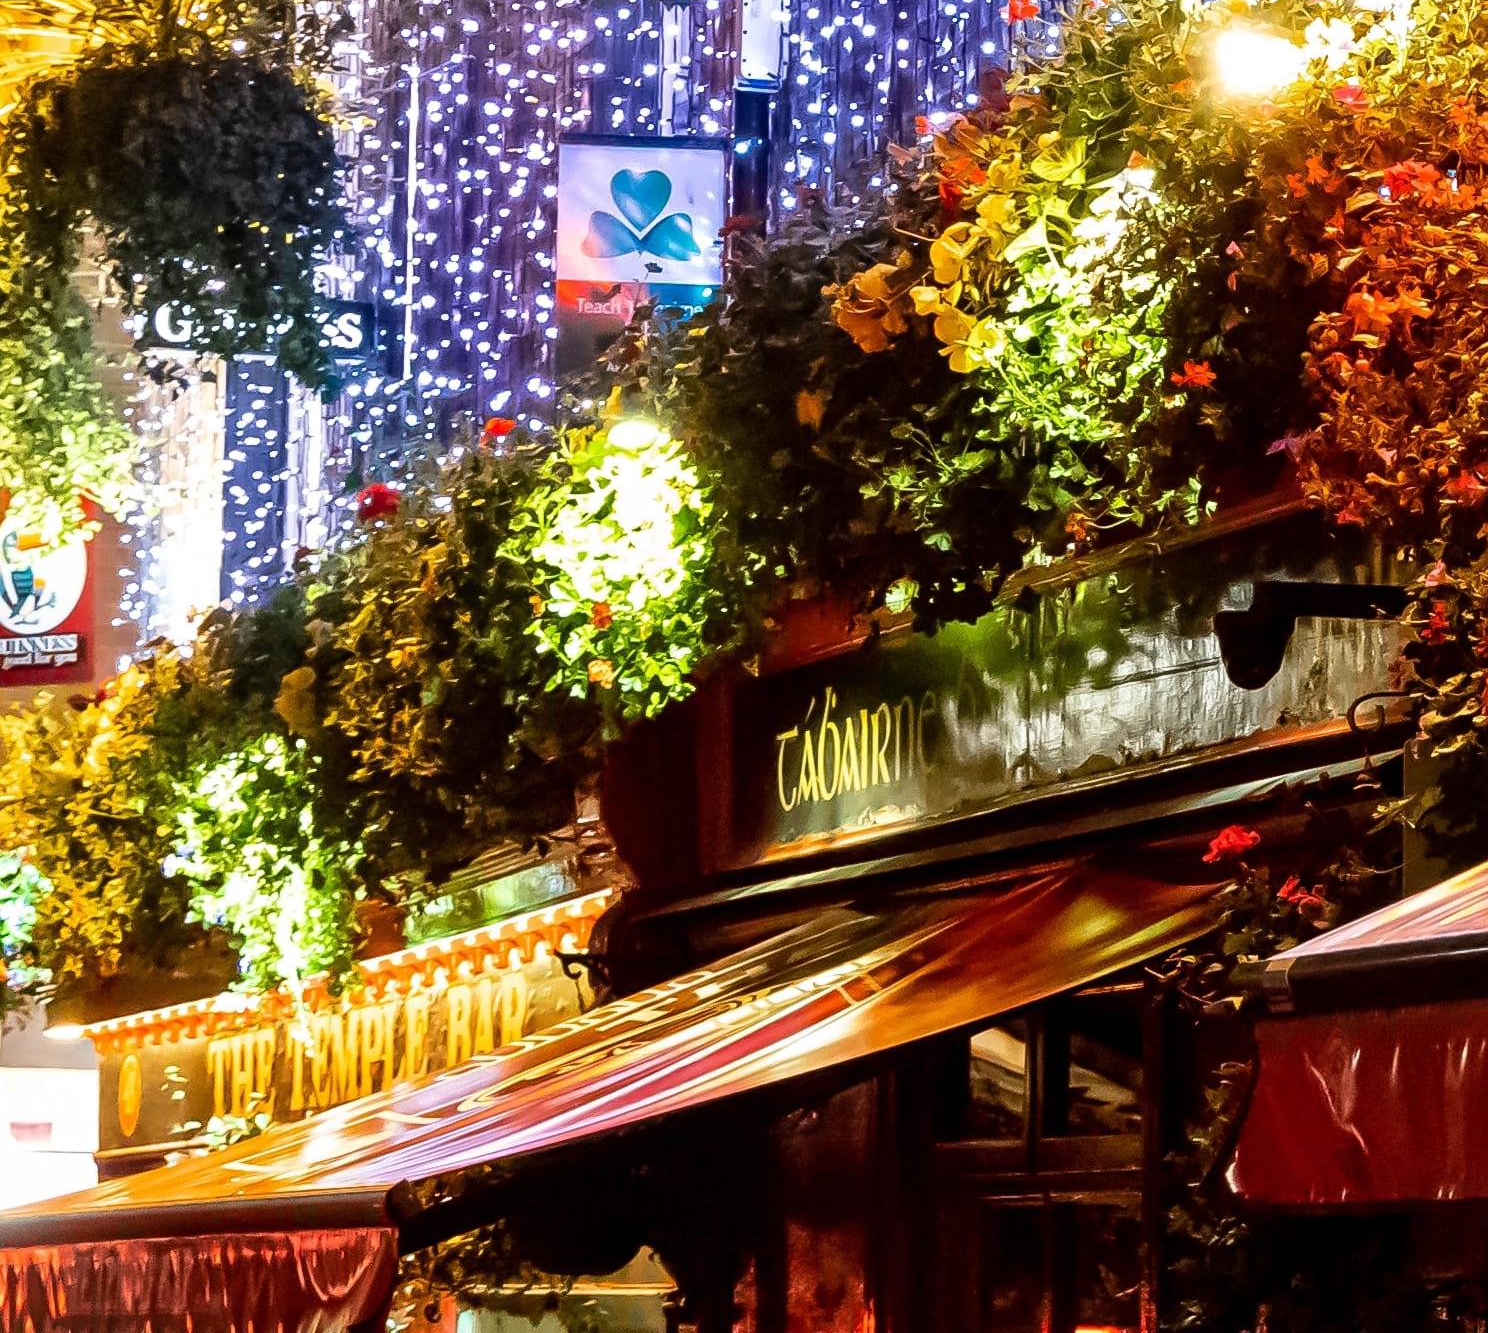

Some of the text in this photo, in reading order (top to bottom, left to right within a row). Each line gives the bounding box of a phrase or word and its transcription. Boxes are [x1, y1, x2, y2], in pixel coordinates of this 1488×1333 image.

[207, 1027, 276, 1117] THE
[286, 995, 430, 1113] TEMPLE
[447, 971, 529, 1068] BAR
